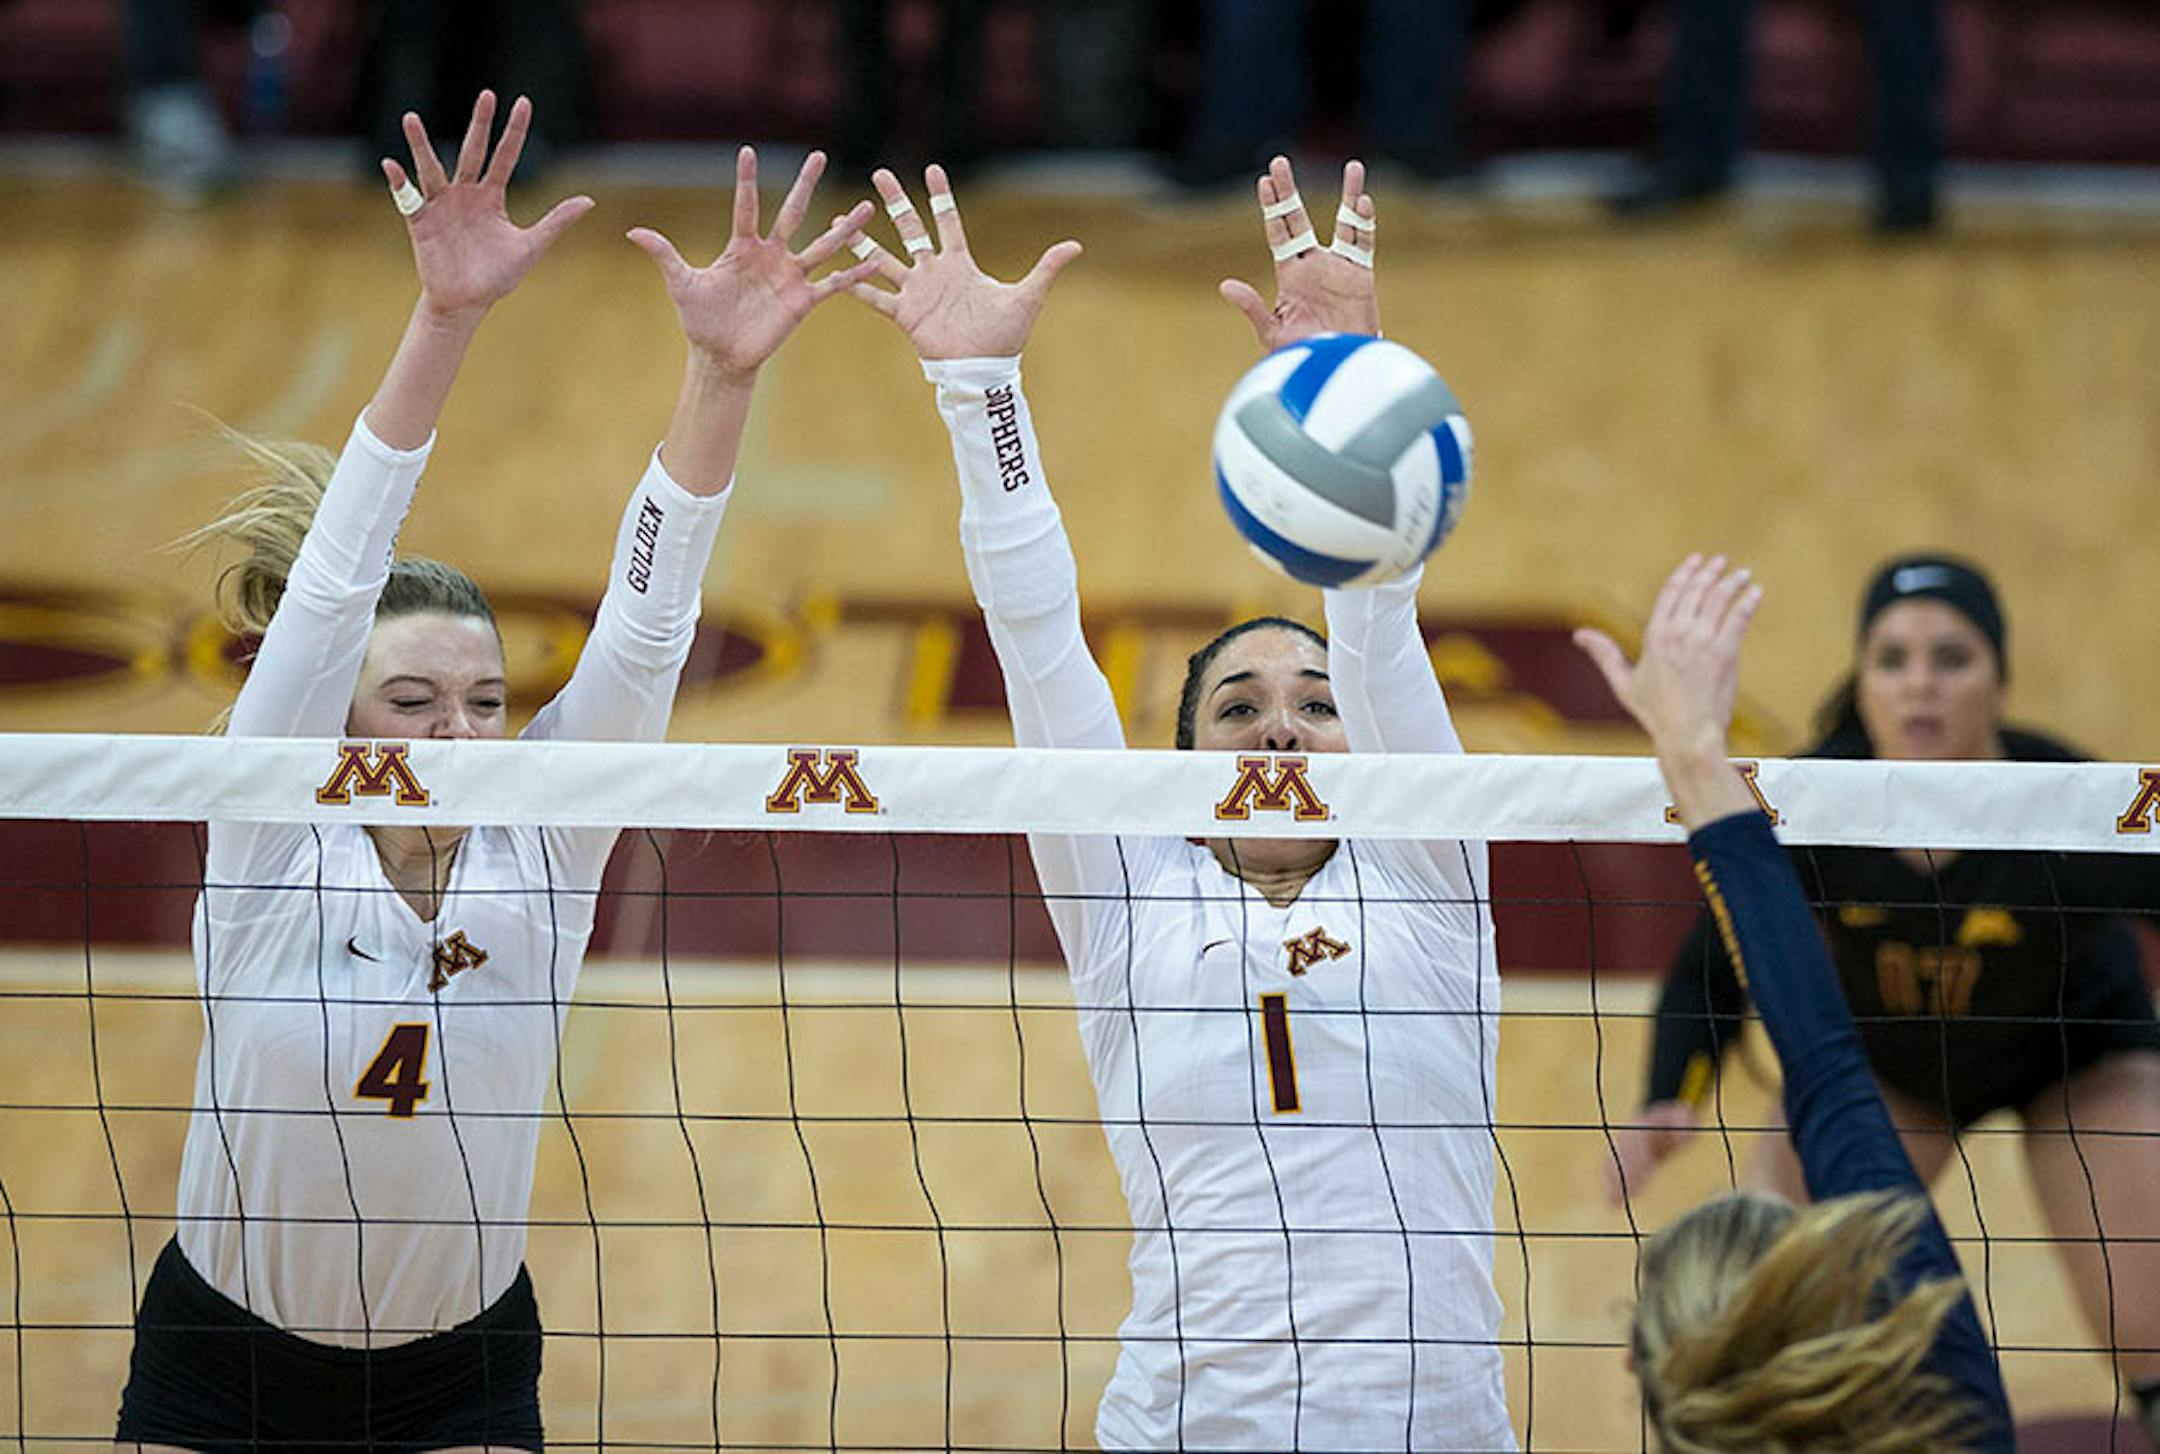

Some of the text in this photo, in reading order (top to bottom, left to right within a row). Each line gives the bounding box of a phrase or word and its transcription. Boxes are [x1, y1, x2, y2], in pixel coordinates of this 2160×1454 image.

[627, 496, 664, 594] GOLDEN
[316, 741, 430, 807] M
[766, 748, 879, 813] M
[1215, 756, 1329, 821] M
[353, 1021, 432, 1120] 4
[1259, 992, 1303, 1114] 1
